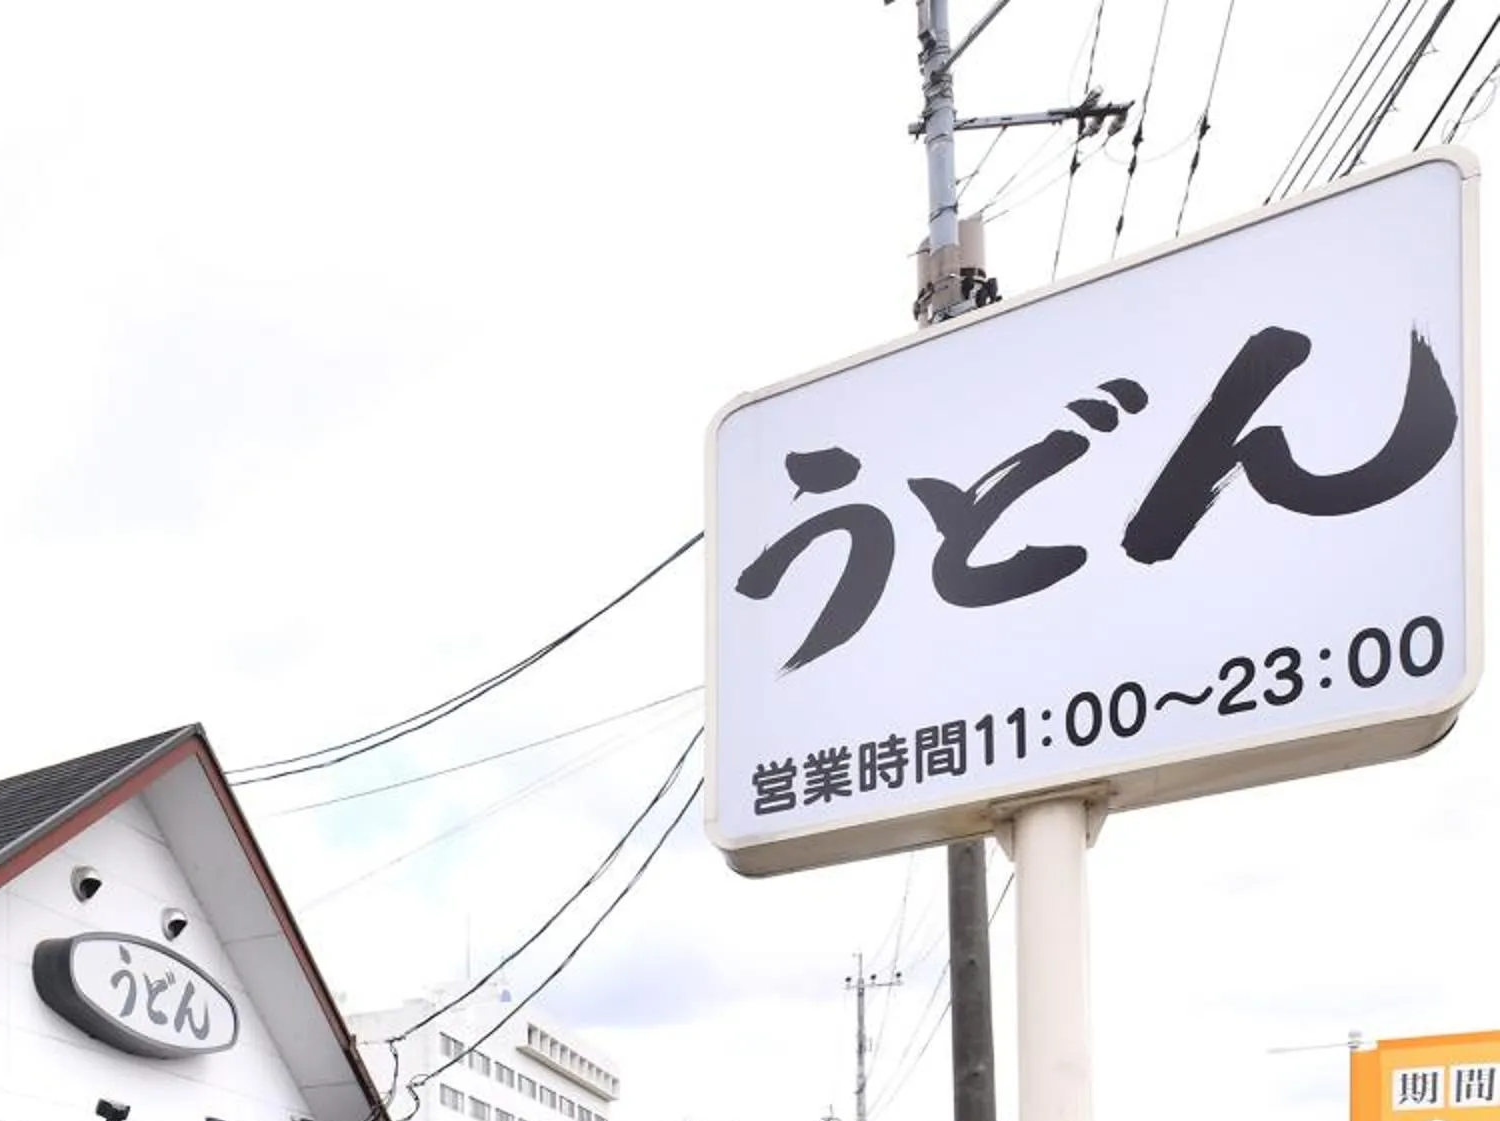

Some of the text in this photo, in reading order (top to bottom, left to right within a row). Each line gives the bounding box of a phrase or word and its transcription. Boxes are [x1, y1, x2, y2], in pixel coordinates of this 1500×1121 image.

[735, 320, 1459, 680] うどん
[110, 944, 210, 1040] うどん
